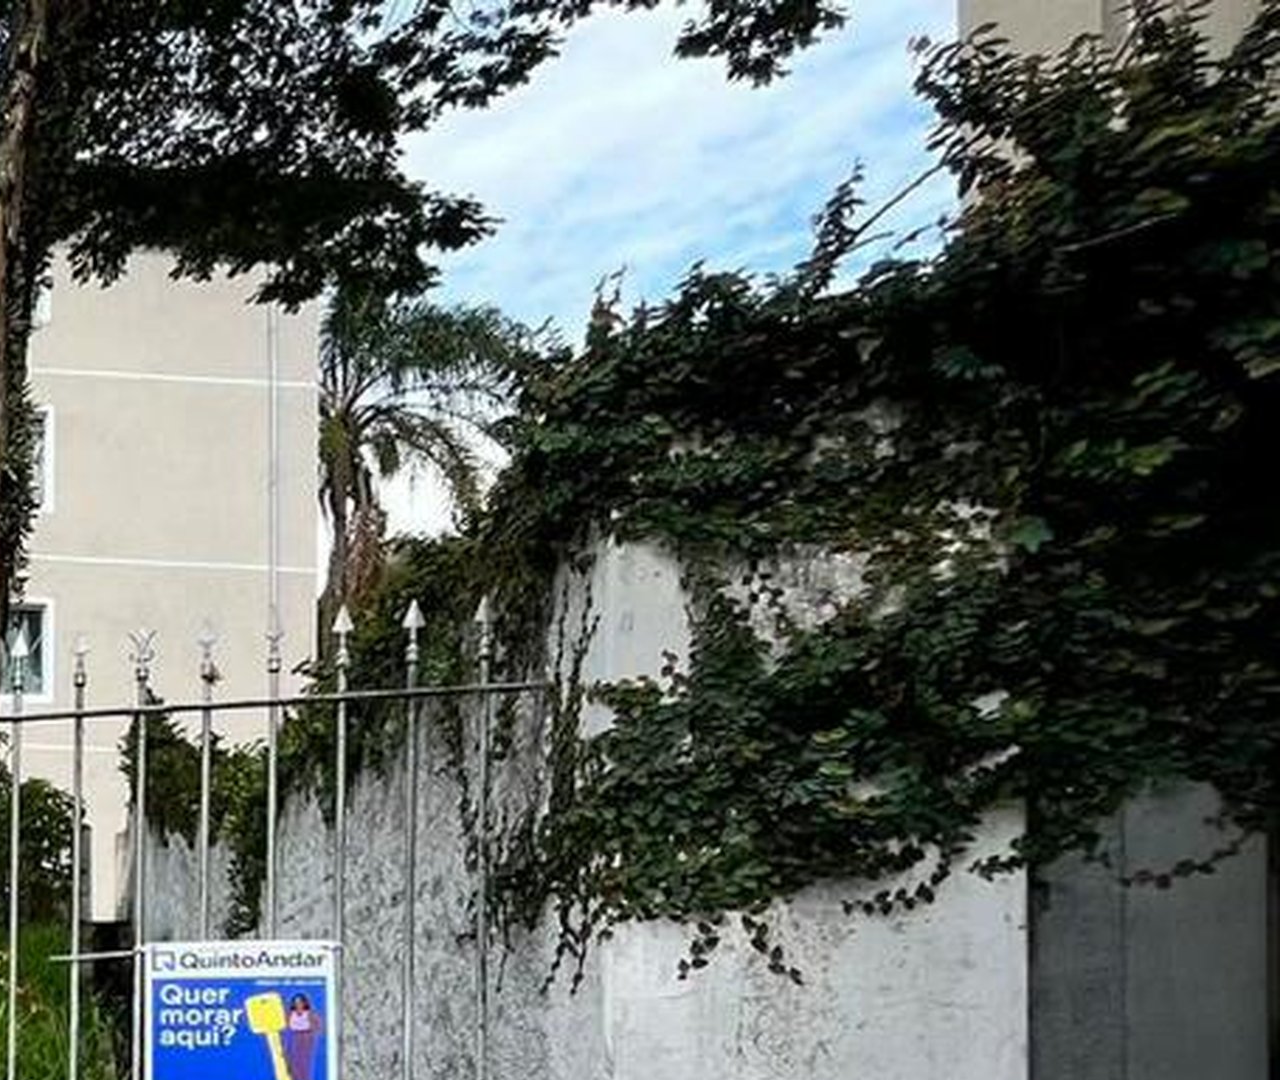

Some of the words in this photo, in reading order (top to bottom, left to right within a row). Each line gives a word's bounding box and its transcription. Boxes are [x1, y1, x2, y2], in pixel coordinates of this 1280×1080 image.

[179, 951, 324, 969] QuintoAndar
[160, 984, 231, 1005] Quer
[160, 1008, 243, 1025] morar
[160, 1025, 237, 1050] aqui?
